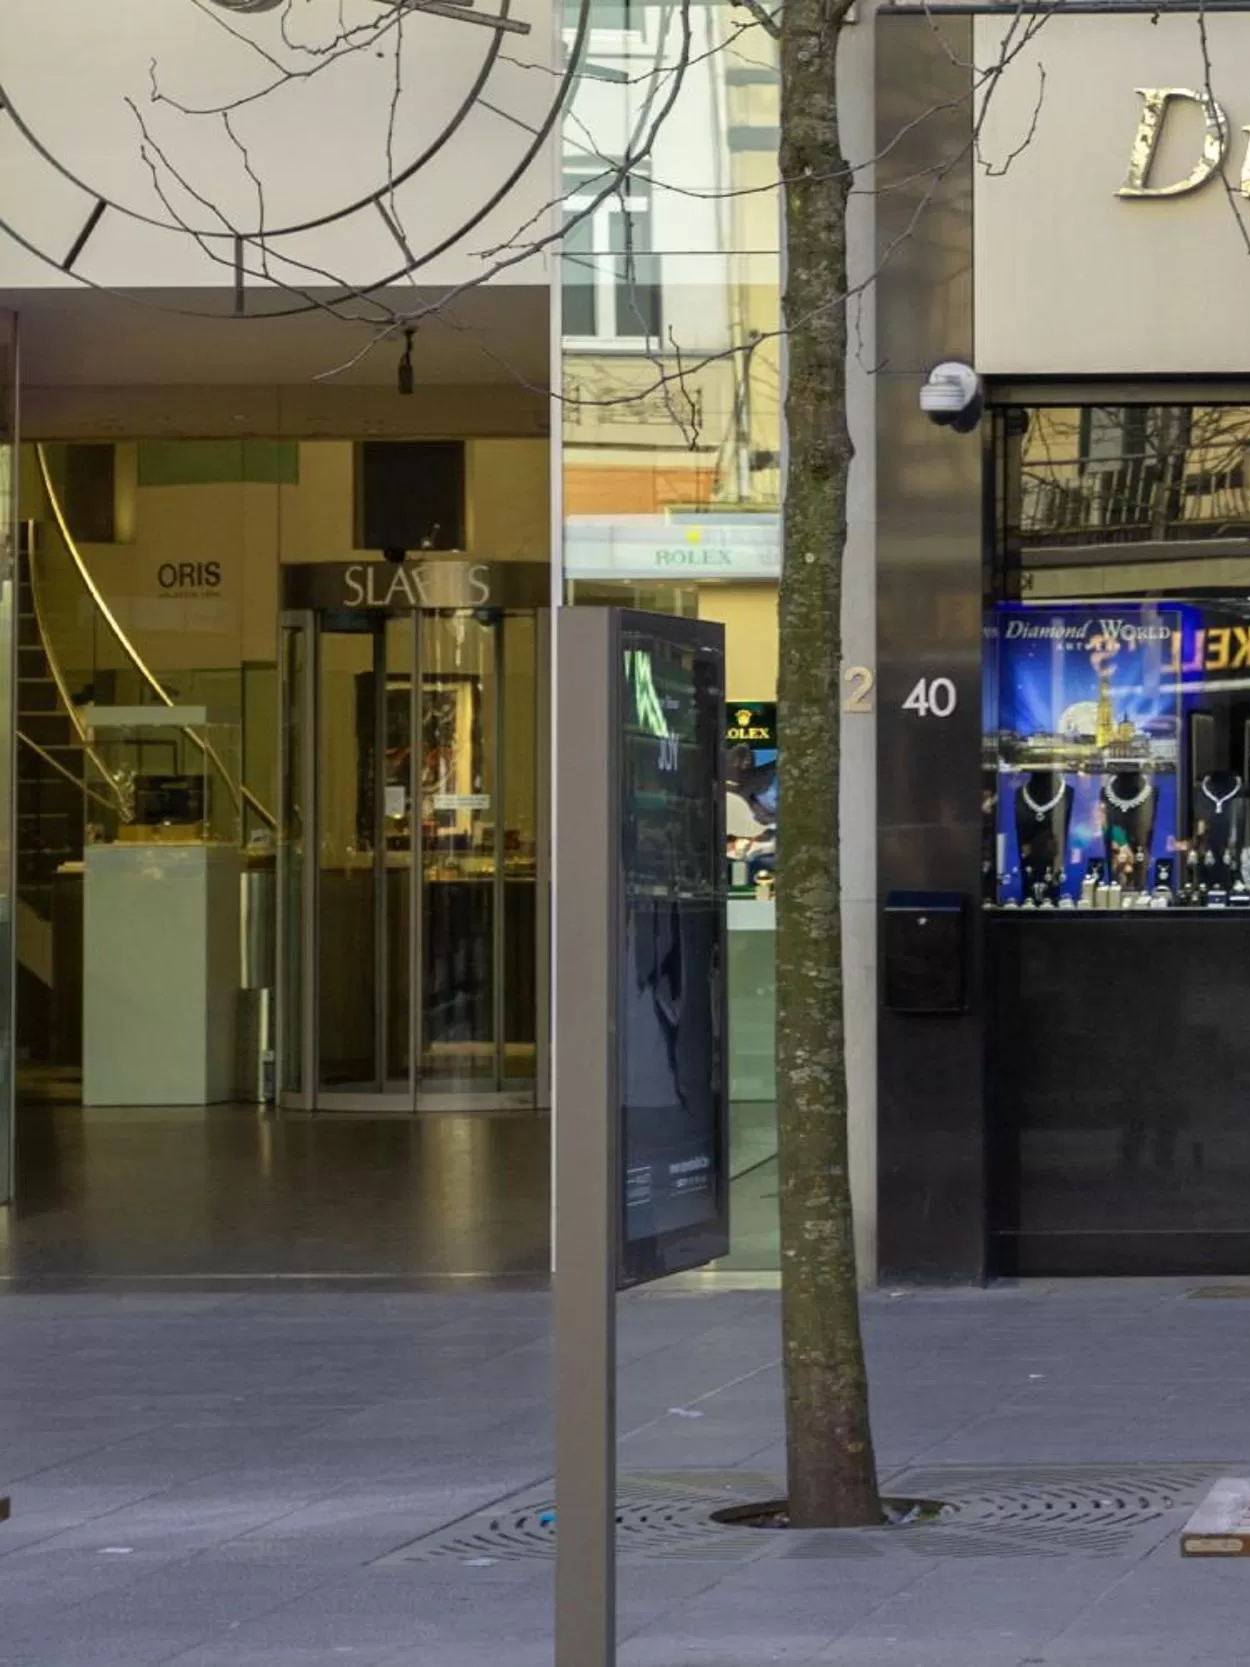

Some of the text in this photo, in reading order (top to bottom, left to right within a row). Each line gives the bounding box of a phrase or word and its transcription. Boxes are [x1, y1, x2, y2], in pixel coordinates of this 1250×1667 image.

[655, 548, 732, 565] ROLEX
[157, 561, 221, 588] ORIS
[1004, 619, 1091, 640] Diamond
[1099, 619, 1170, 641] WORLD
[844, 665, 873, 713] 2
[901, 677, 956, 718] 40
[725, 727, 770, 740] OLEX
